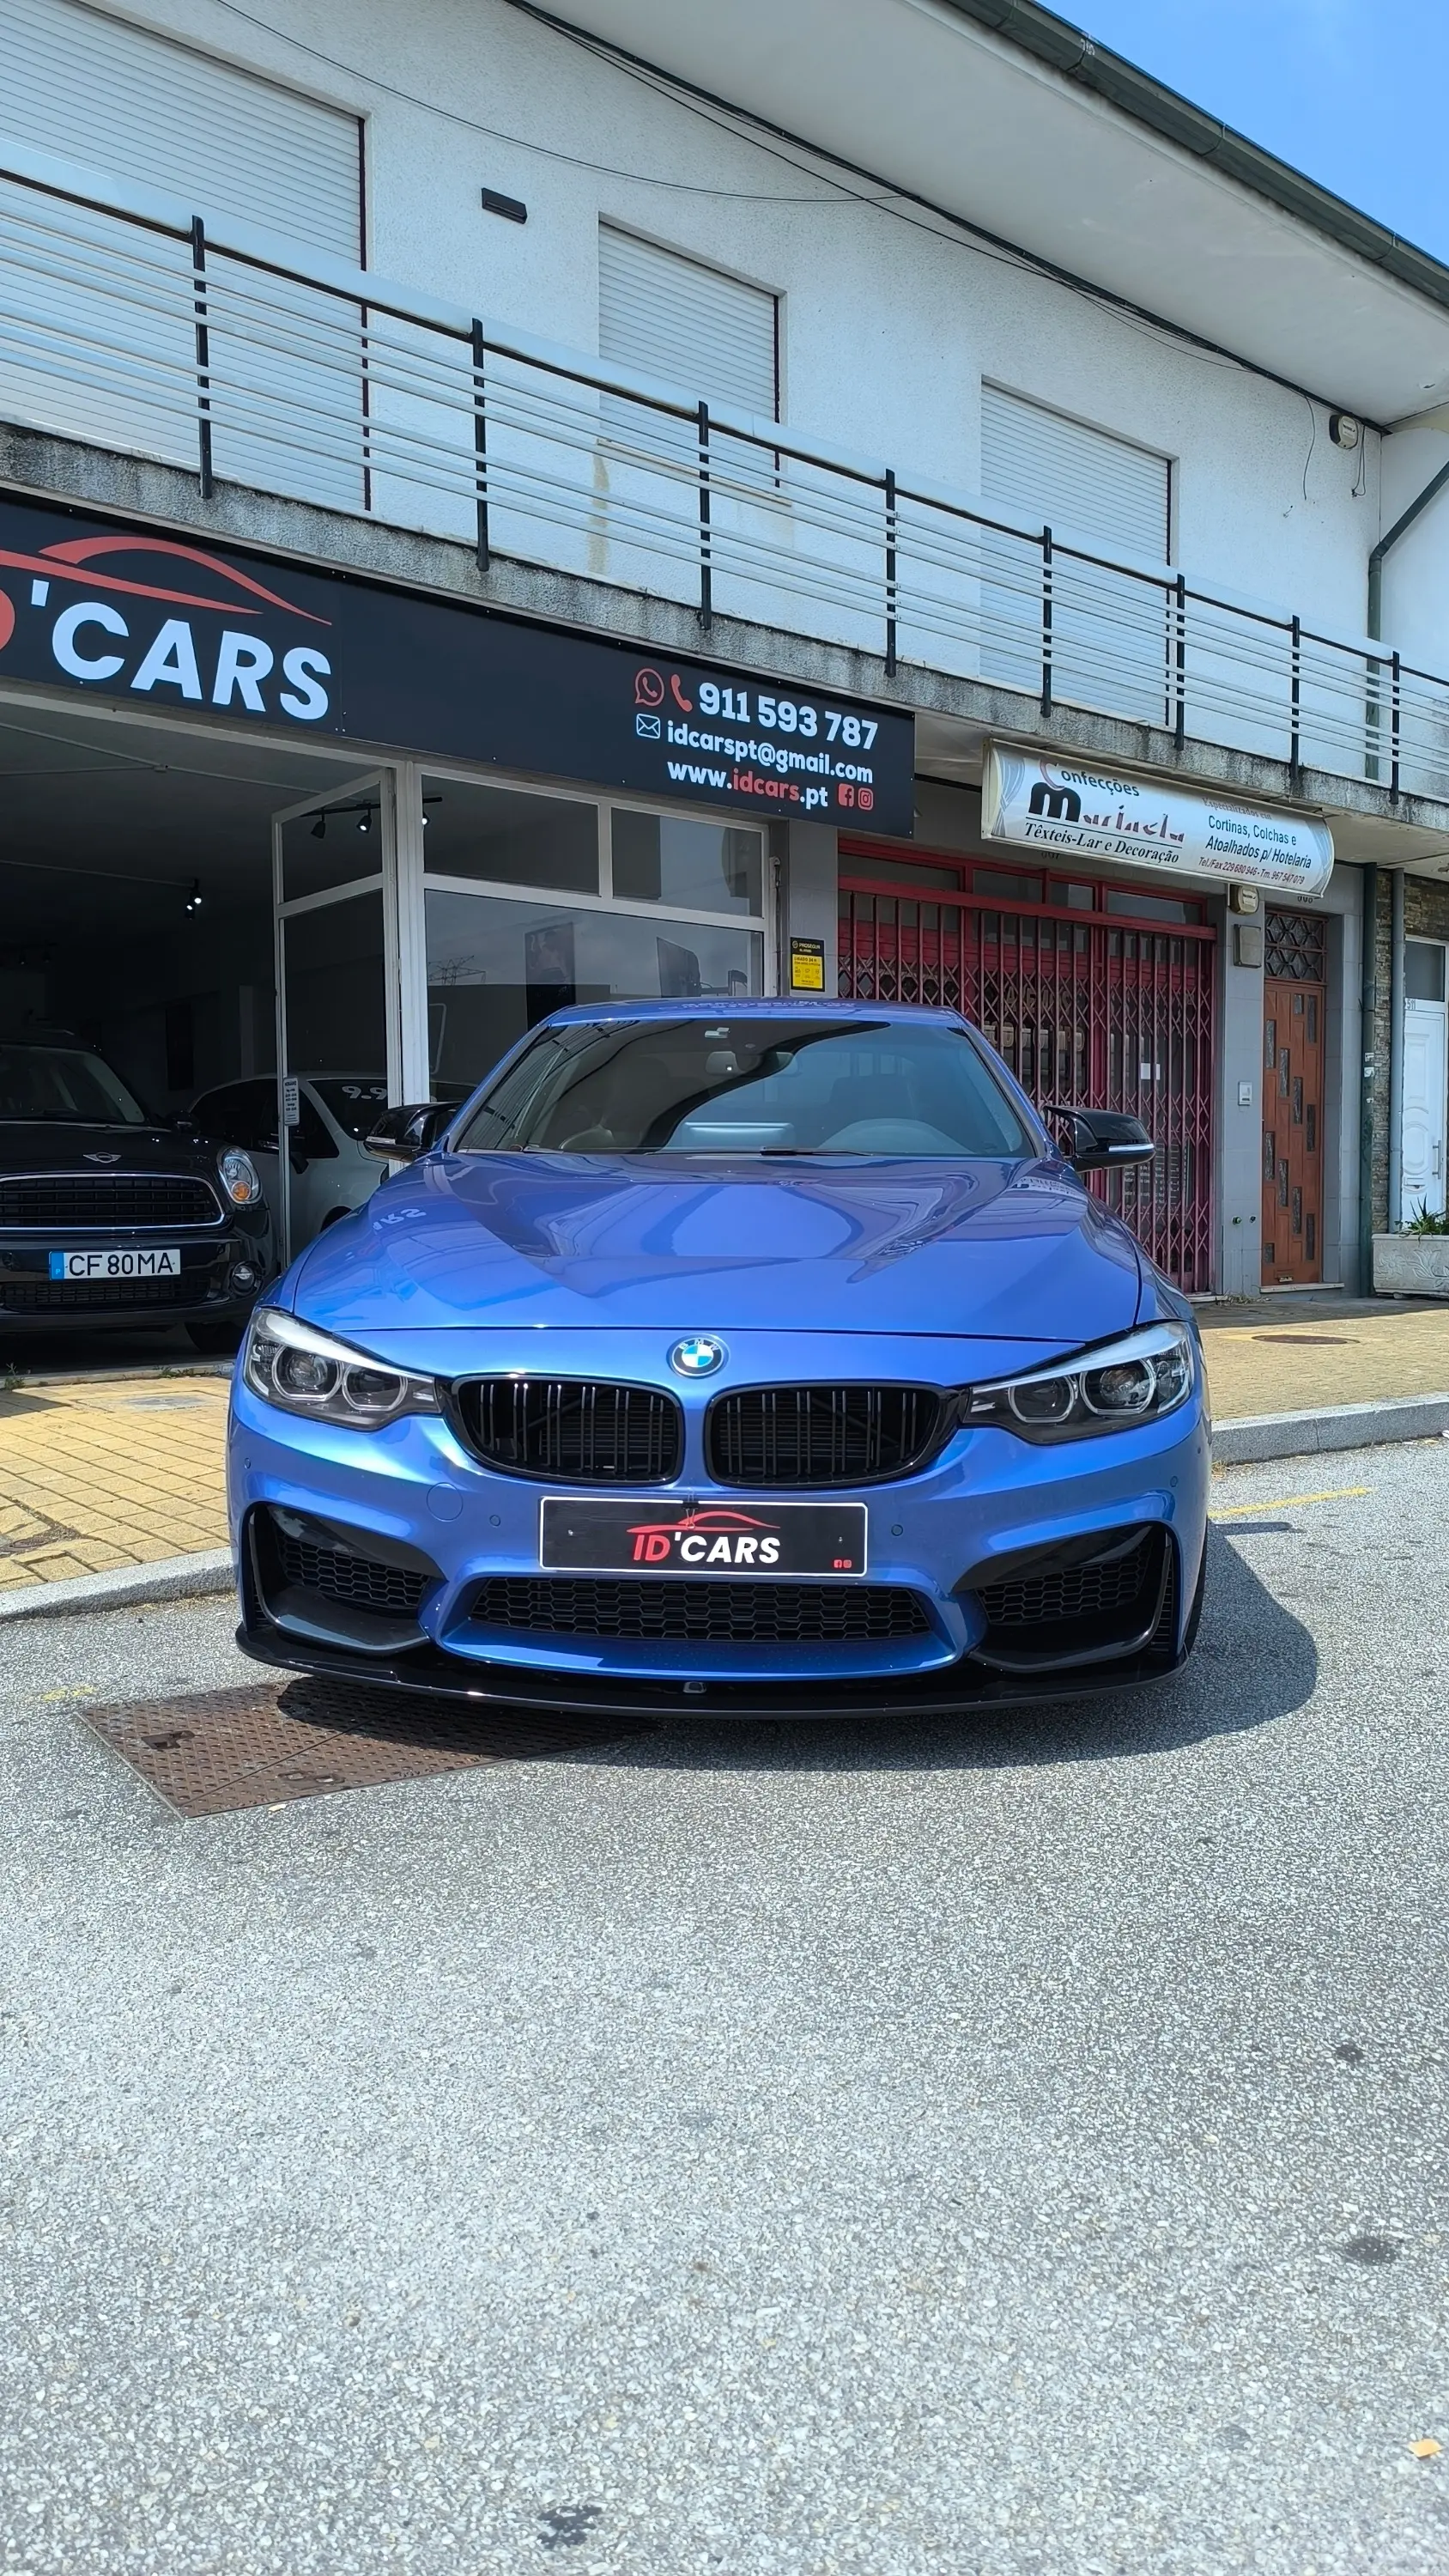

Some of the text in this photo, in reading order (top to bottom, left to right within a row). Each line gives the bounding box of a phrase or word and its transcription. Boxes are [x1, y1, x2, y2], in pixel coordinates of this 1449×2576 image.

[0, 580, 331, 720] 'CARS
[699, 682, 878, 750] 911 593 787
[667, 720, 873, 783] idcarspt@gmail.com
[667, 761, 828, 810] www.idcars.pt
[1024, 821, 1180, 864] Têxteis-Lar e Decoração
[1209, 815, 1297, 846] Cortinas, Colchas e
[1205, 835, 1312, 869] Atoalhados p/ Hotelaria
[1222, 861, 1234, 872] 229
[1260, 868, 1270, 878] Tm.
[69, 1252, 173, 1276] CF 80 MA
[678, 1339, 720, 1352] BMW
[633, 1531, 781, 1564] ID'CARS
